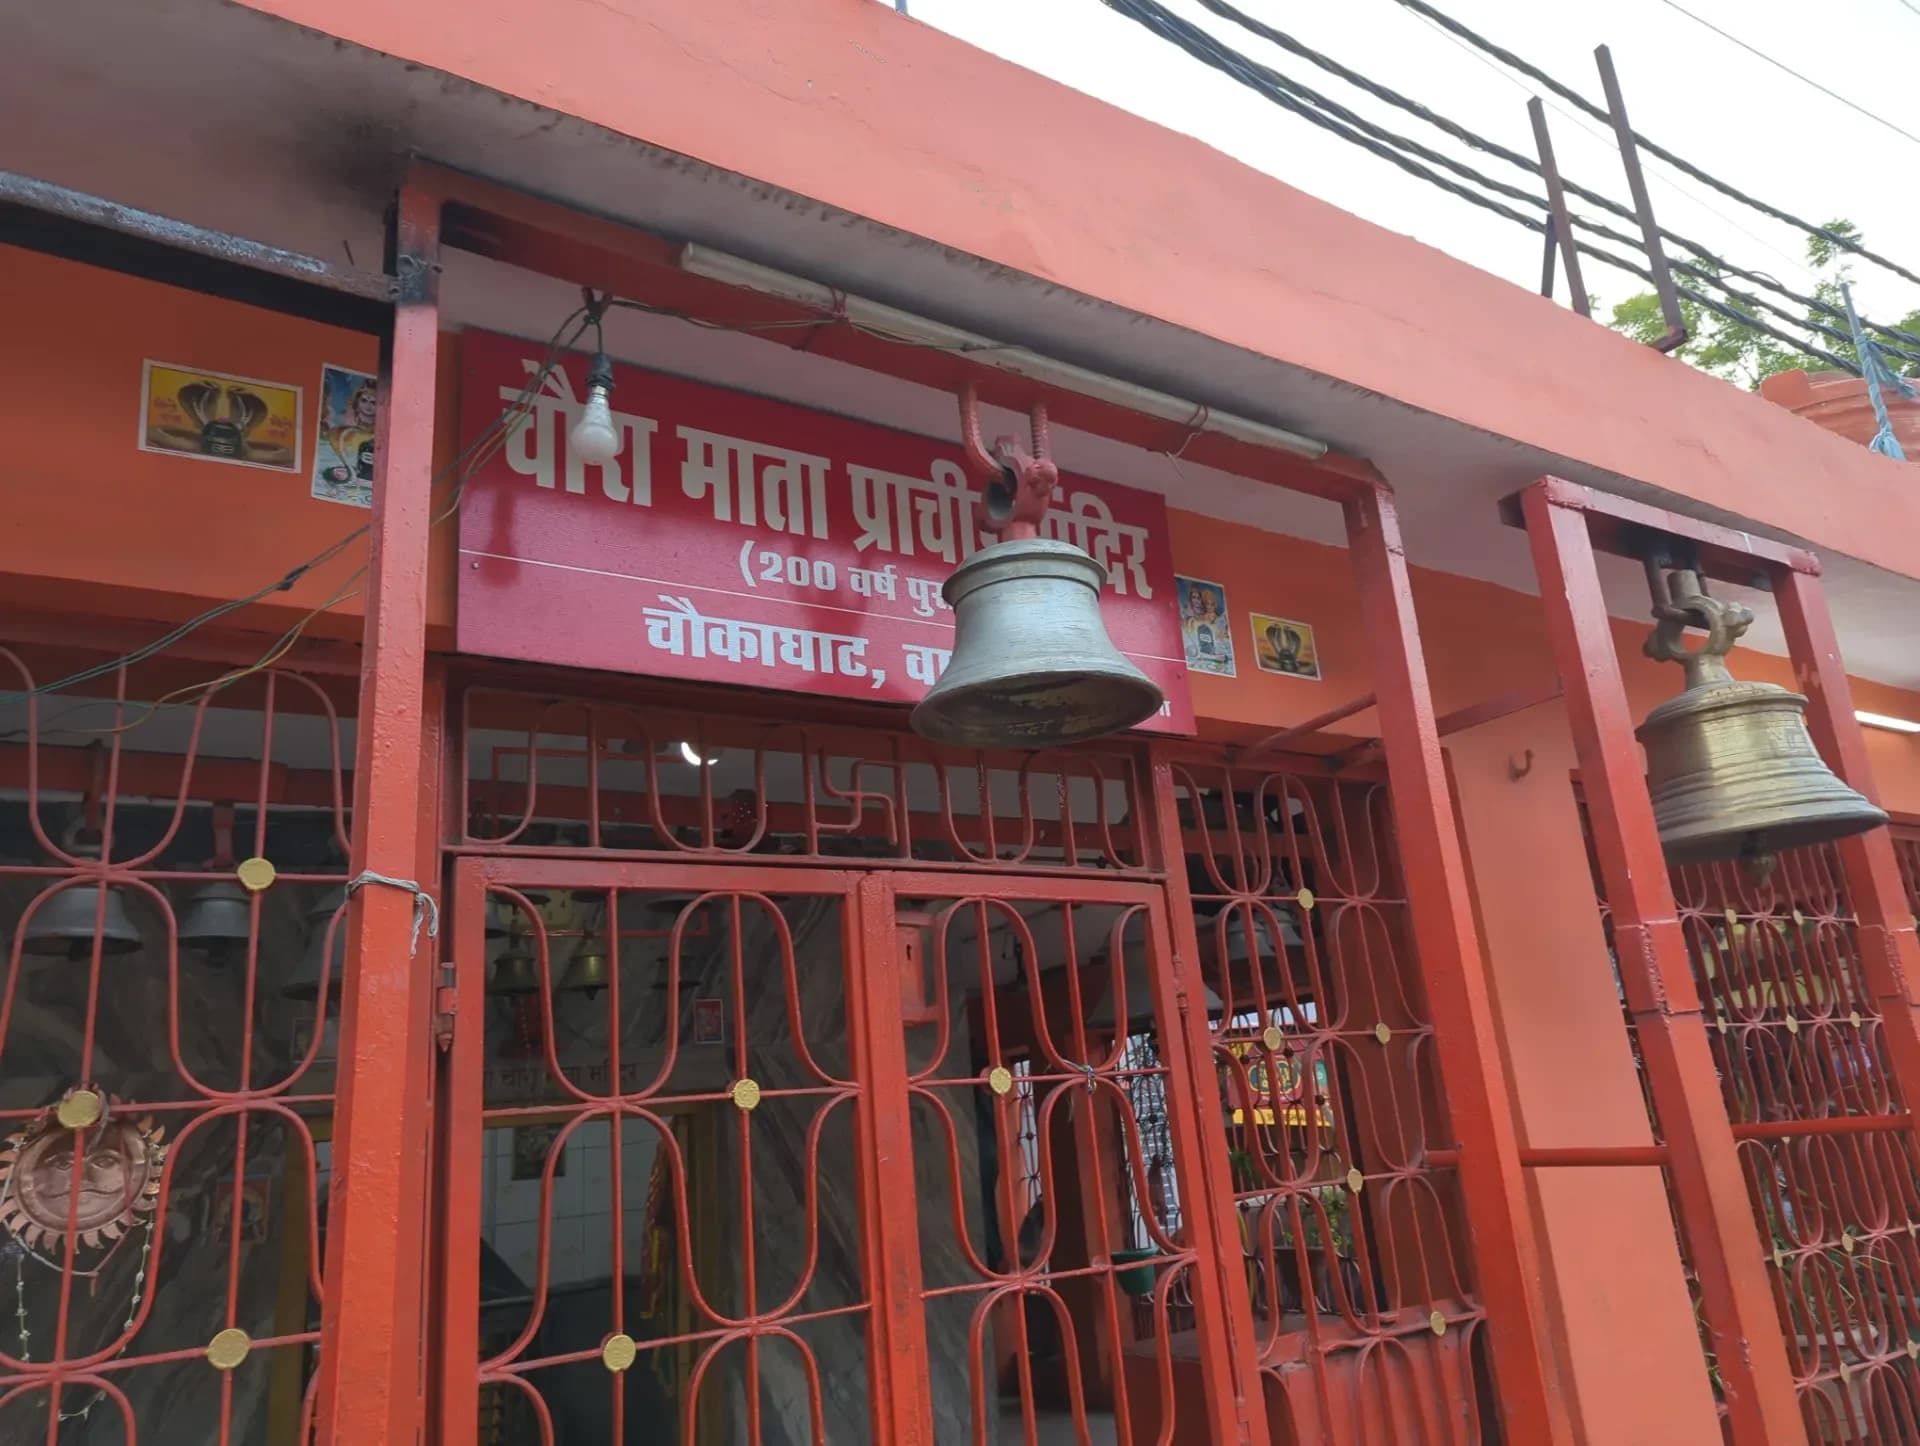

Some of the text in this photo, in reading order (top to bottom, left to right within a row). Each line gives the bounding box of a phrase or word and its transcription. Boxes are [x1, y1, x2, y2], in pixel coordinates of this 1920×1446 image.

[676, 424, 831, 540] माता
[847, 458, 998, 564] प्राची
[740, 540, 836, 592] (200
[848, 565, 897, 601] वर्ष
[642, 595, 886, 689] चौकाघाट,
